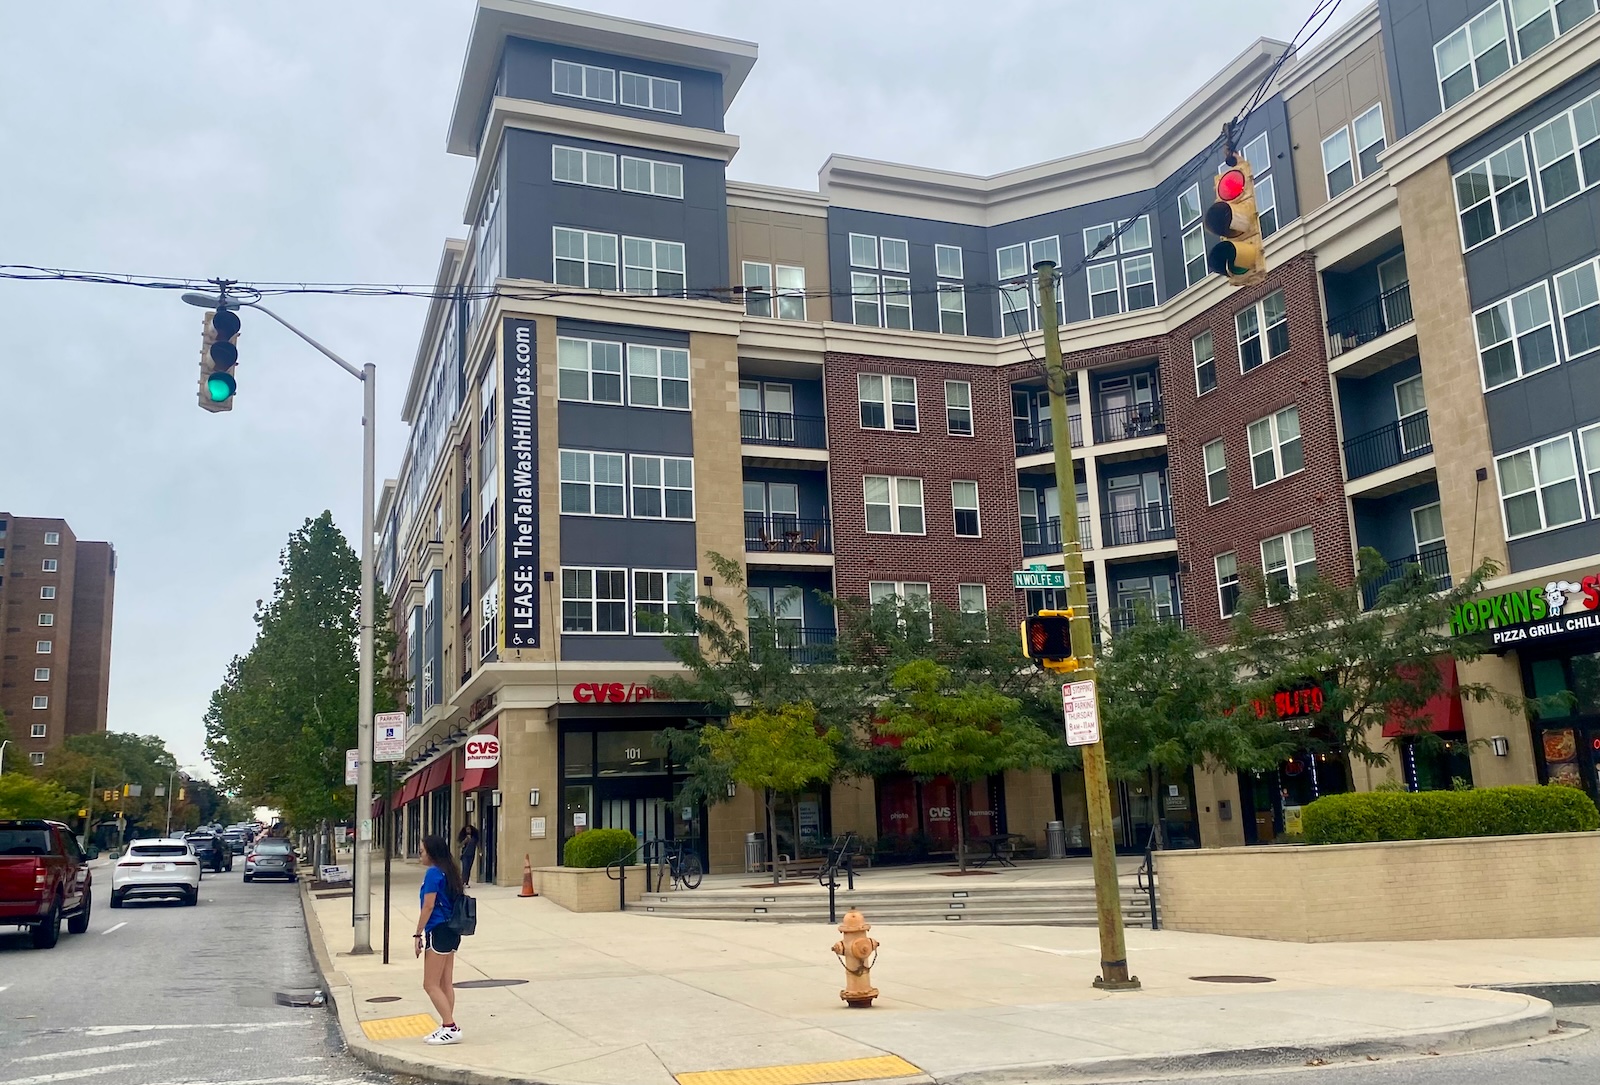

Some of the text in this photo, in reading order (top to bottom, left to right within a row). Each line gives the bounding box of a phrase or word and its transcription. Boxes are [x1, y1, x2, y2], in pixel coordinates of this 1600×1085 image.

[511, 326, 535, 629] LEASE: TheTalaWashHillApts.com
[1450, 573, 1600, 636] HOPKINS S
[1493, 629, 1527, 644] PIZZA
[1529, 622, 1564, 637] GRILL
[1072, 683, 1093, 694] STOPPING
[1074, 700, 1094, 711] PARKING
[1068, 711, 1093, 720] THURSDAY
[467, 741, 499, 754] CVS
[625, 748, 641, 759] 101
[890, 812, 909, 821] photo
[928, 806, 951, 817] CVS
[968, 809, 995, 817] harmacy
